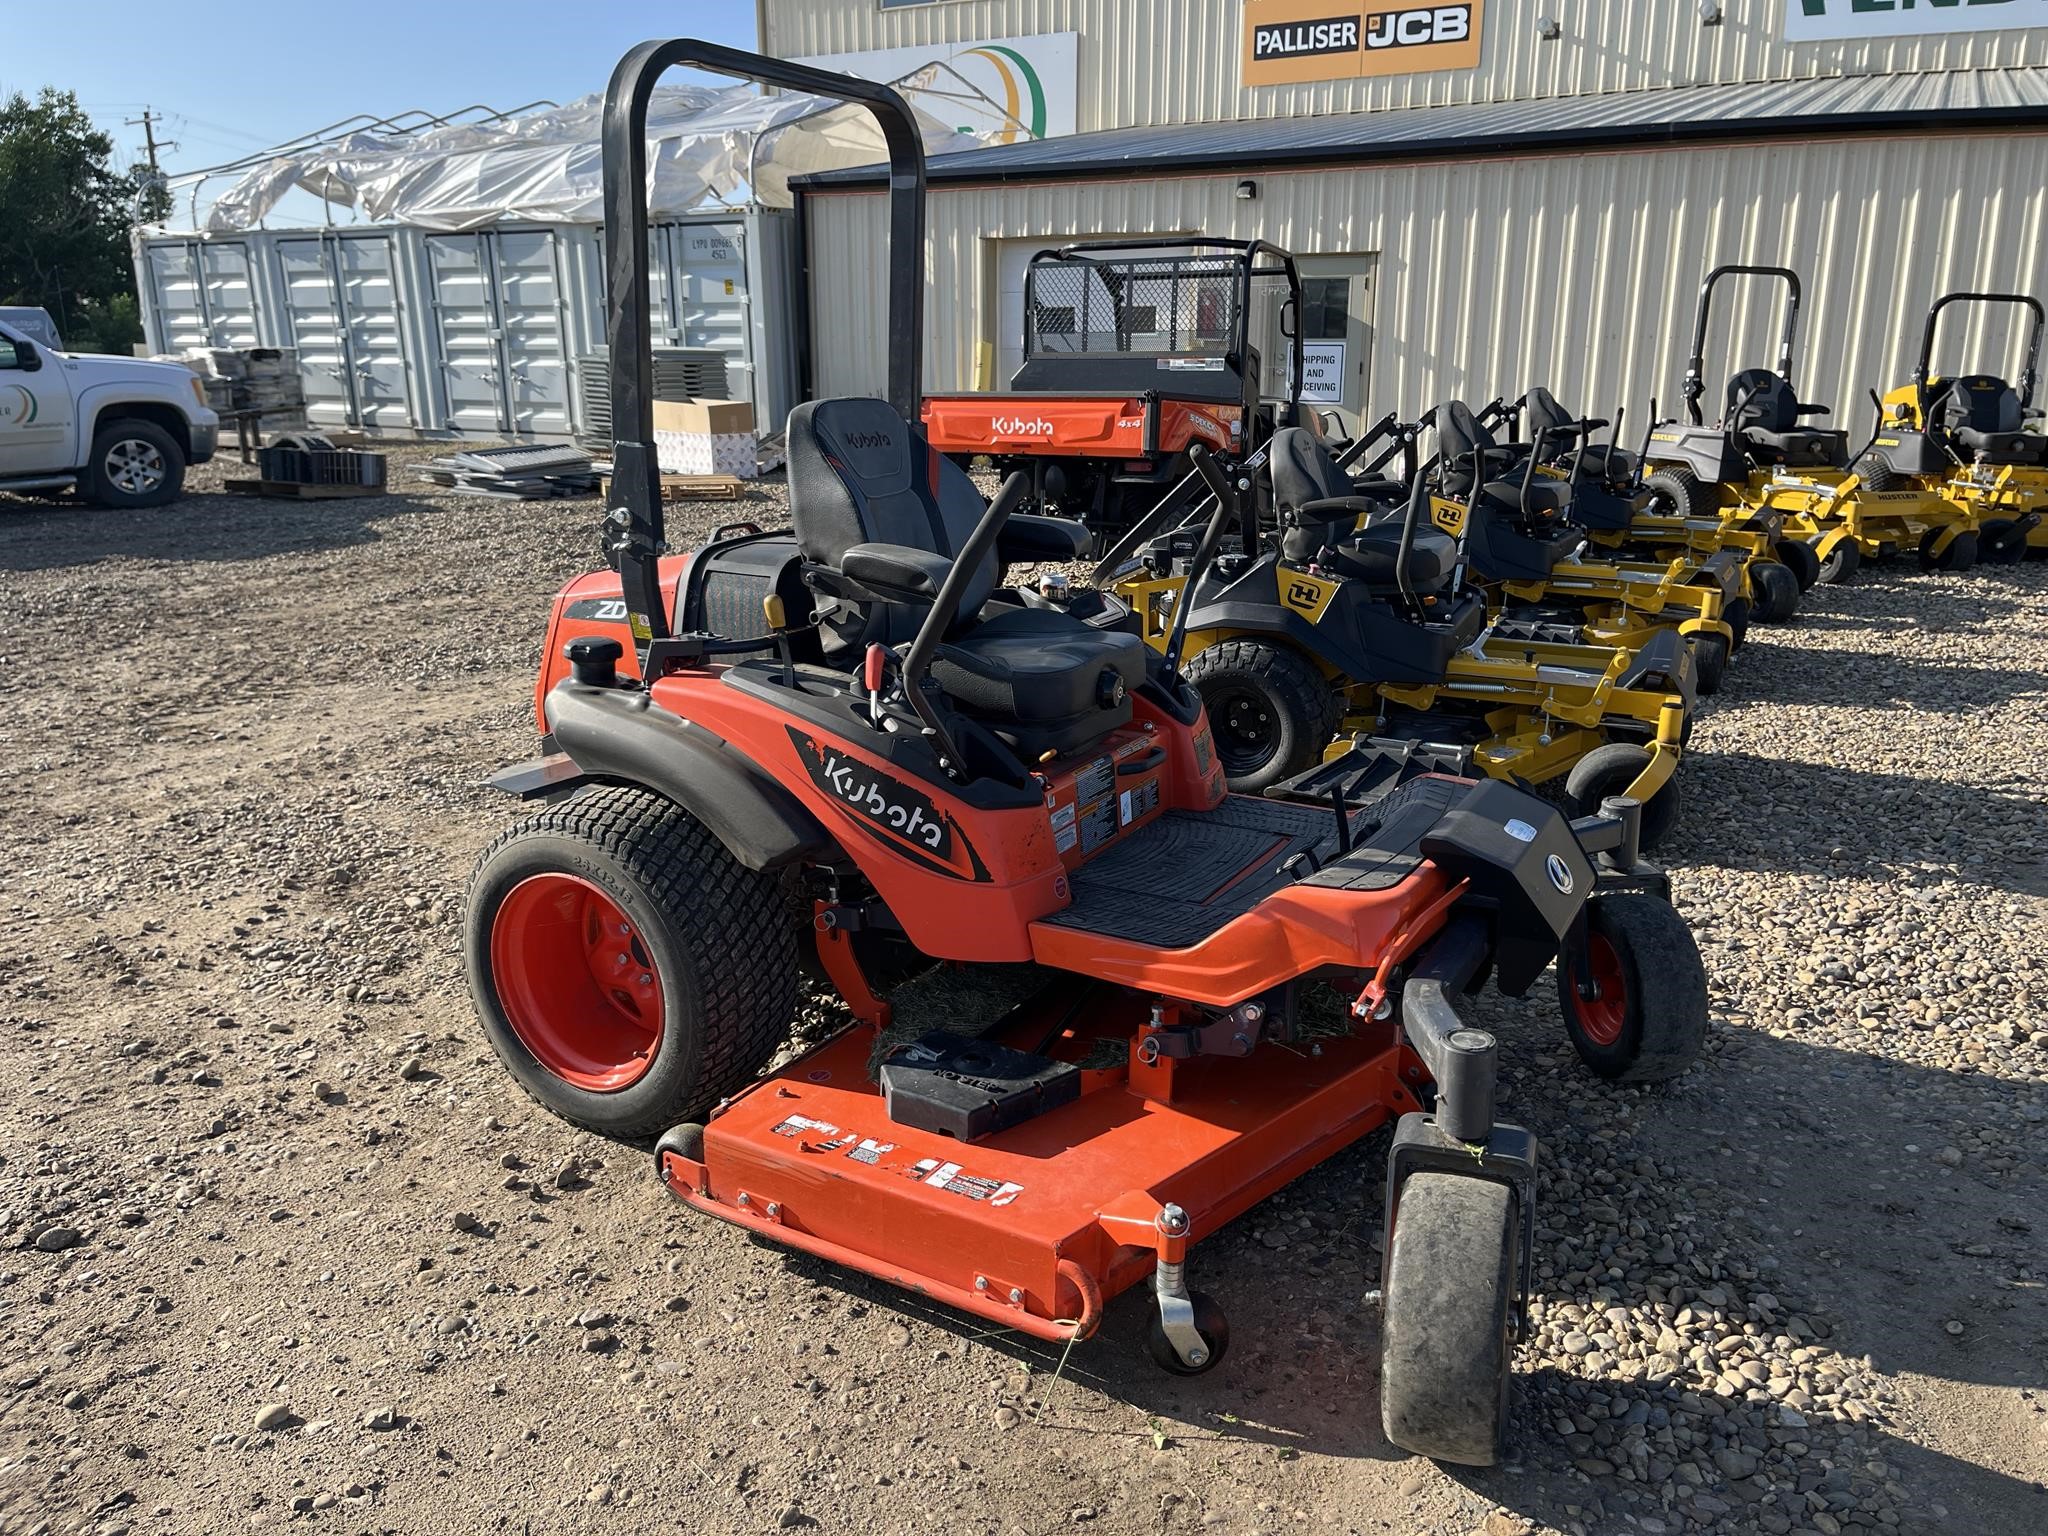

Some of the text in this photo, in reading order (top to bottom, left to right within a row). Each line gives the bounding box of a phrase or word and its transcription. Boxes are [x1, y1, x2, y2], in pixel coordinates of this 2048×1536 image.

[1256, 7, 1469, 55] PALLISER JCB
[1302, 355, 1336, 365] HIPPING
[1306, 368, 1324, 378] AND
[1301, 382, 1336, 392] CEIVING
[992, 417, 1054, 436] Kubota
[1117, 419, 1141, 429] 4x4
[846, 432, 892, 448] Kubota
[1878, 493, 1918, 501] HUSTLER
[824, 756, 942, 848] Kubota
